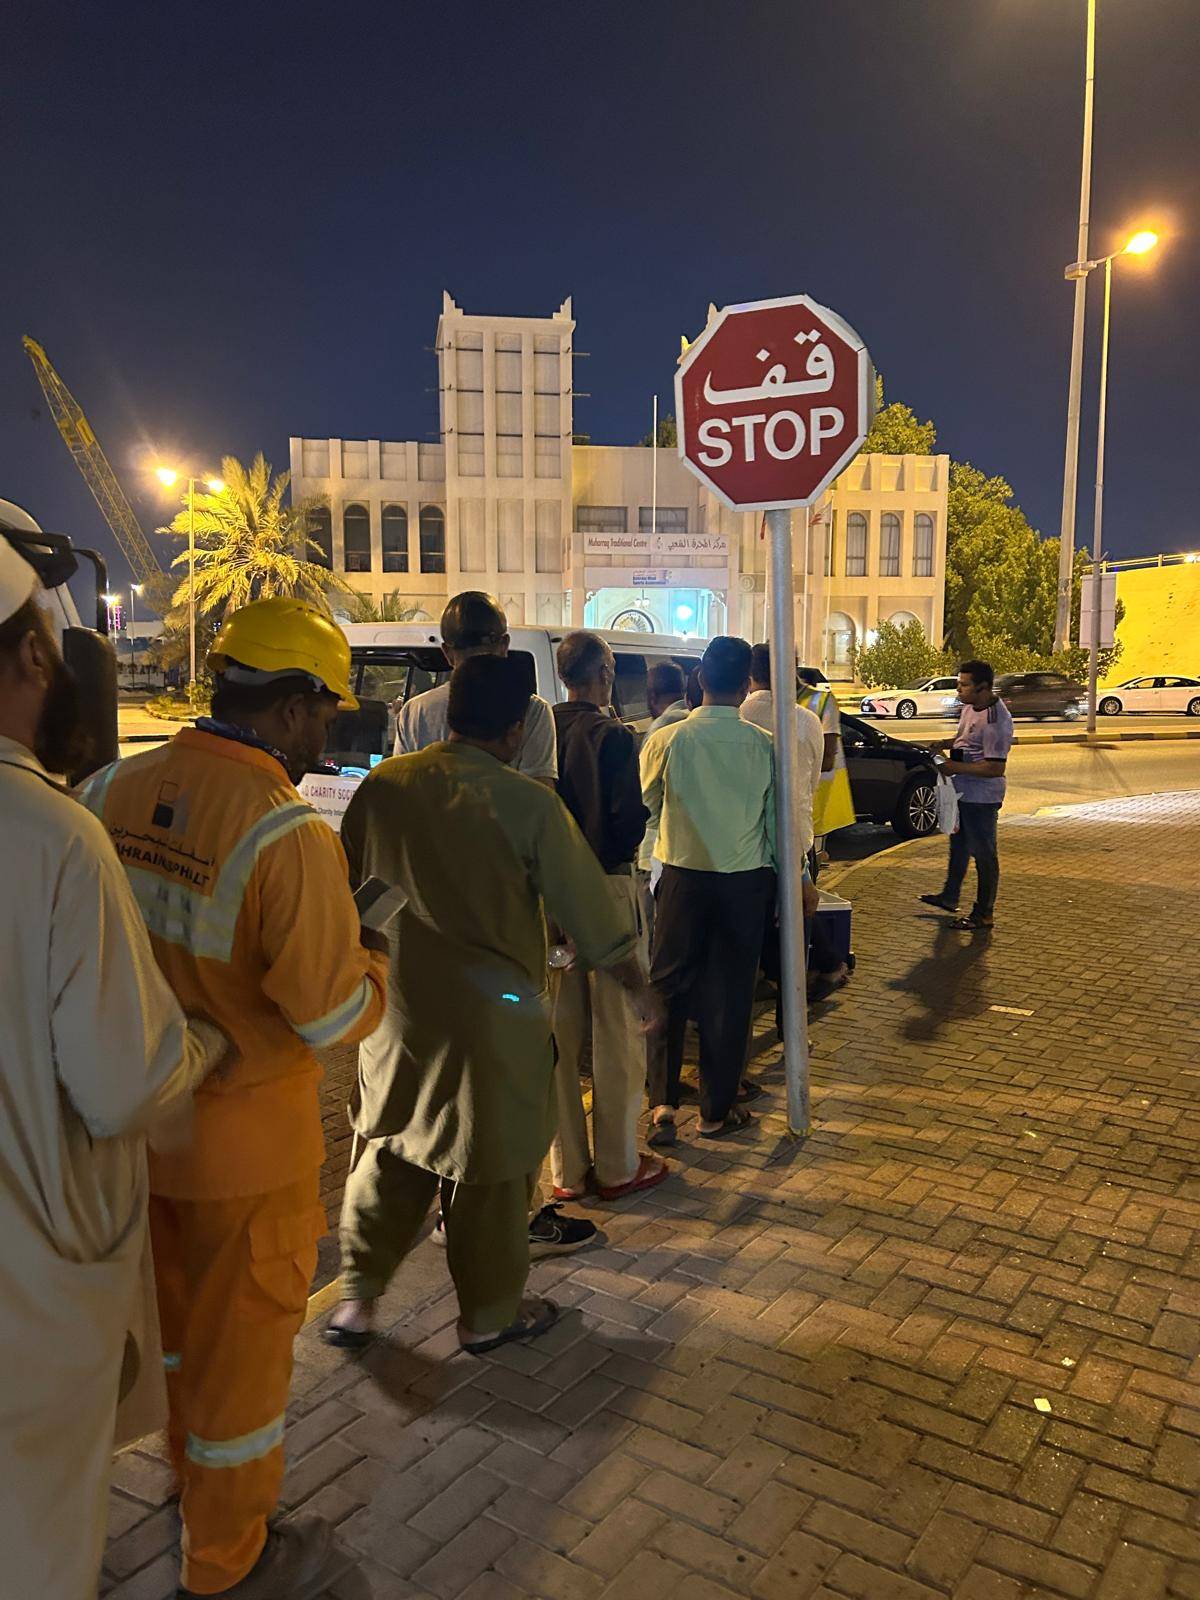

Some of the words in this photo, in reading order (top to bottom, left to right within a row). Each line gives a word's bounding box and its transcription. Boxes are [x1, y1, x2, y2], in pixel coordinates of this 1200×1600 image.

[703, 329, 835, 405] قف
[697, 406, 845, 468] STOP
[588, 537, 610, 549] Muharraq
[610, 537, 632, 547] Traditional
[310, 785, 336, 799] CHARITY
